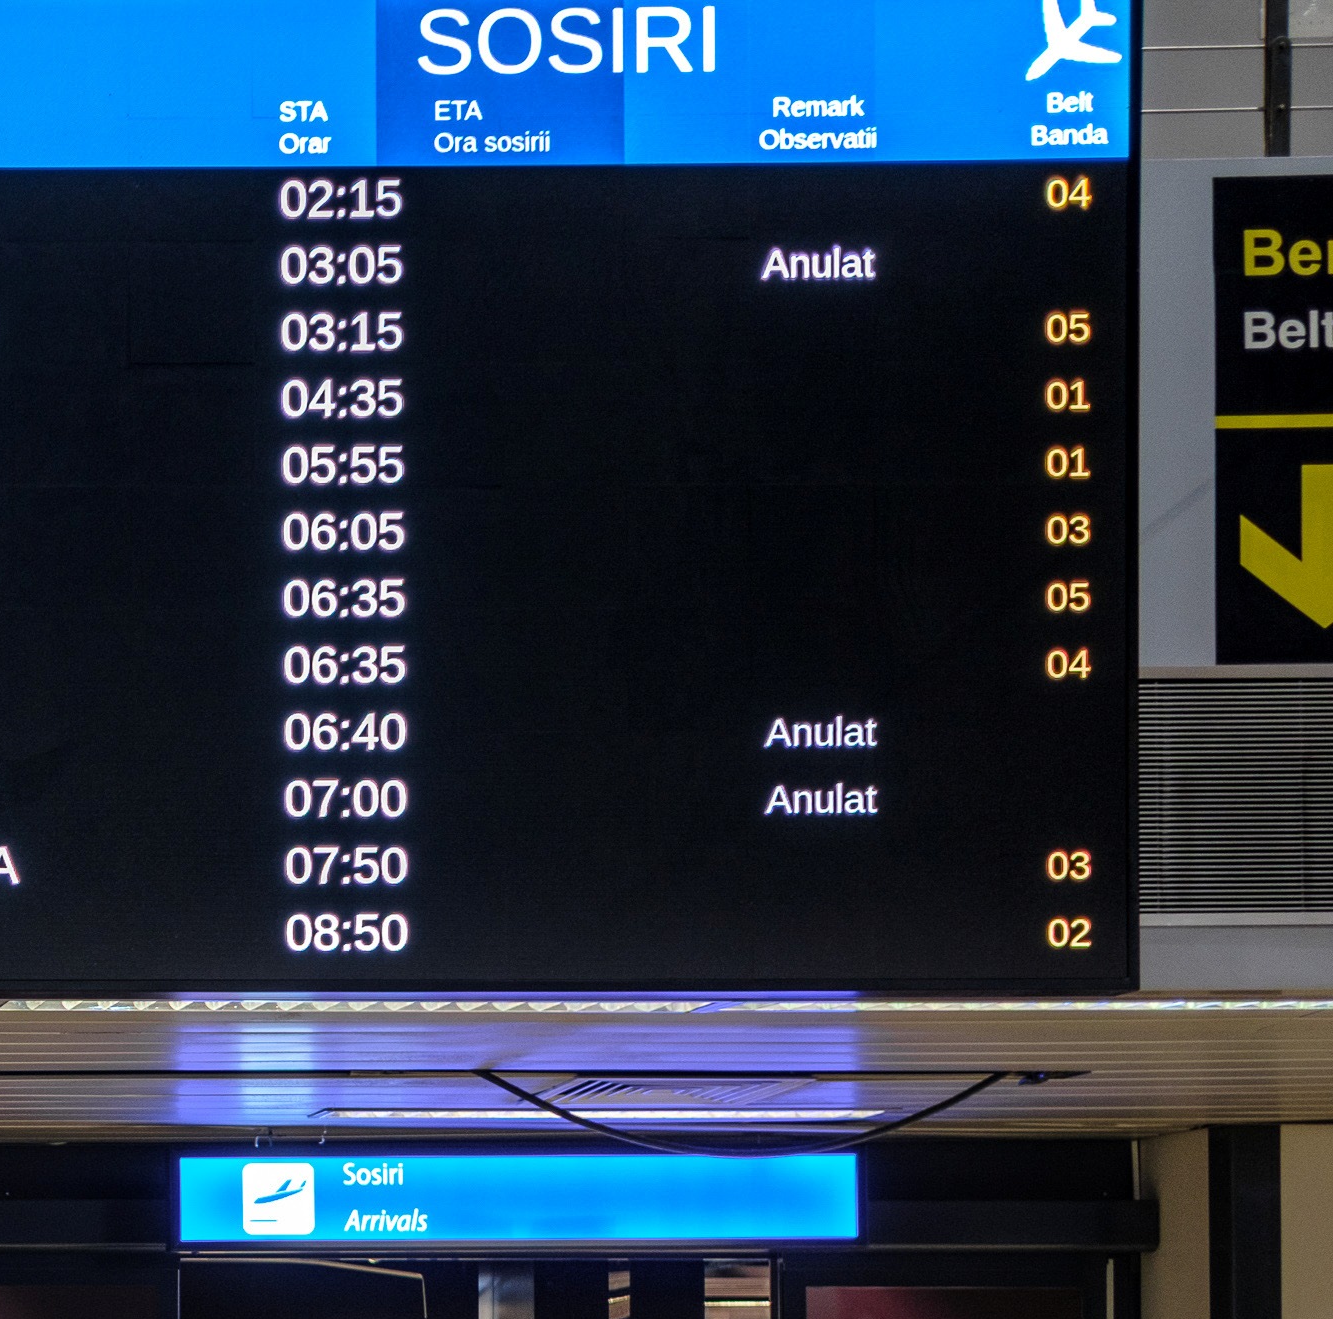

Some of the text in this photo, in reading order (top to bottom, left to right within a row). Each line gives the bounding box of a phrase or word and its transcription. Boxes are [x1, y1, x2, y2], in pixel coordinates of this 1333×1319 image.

[418, 6, 717, 76] SOSIRI
[280, 101, 330, 124] STA
[435, 100, 484, 122] ETA
[773, 95, 866, 119] Remark
[1047, 91, 1095, 115] Belt
[279, 133, 333, 156] Orar
[434, 132, 551, 154] Ora sosirii
[759, 128, 878, 152] Observatii
[1032, 124, 1110, 148] Banda
[281, 180, 404, 221] 02:15
[1046, 176, 1094, 211] 04
[281, 246, 404, 286] 03:05
[761, 245, 878, 282] Anulat
[1244, 229, 1333, 278] Be
[281, 312, 404, 353] 03:15
[1046, 311, 1093, 344] 05
[281, 379, 404, 420] 04:35
[1046, 379, 1092, 411] 01
[282, 445, 406, 487] 05:55
[1046, 446, 1092, 479] 01
[283, 511, 407, 552] 06:05
[1046, 514, 1093, 547] 03
[284, 579, 407, 619] 06:35
[1046, 582, 1093, 614] 05
[284, 646, 407, 687] 06:35
[1046, 648, 1093, 680] 04
[284, 713, 409, 752] 06:40
[764, 716, 879, 749] Anulat
[284, 780, 409, 819] 07:00
[765, 783, 879, 815] Anulat
[285, 847, 410, 886] 07:50
[1047, 850, 1093, 881] 03
[286, 914, 410, 953] 08:50
[1047, 917, 1093, 949] 02
[343, 1162, 405, 1187] Sosiri
[345, 1209, 429, 1233] Arrivals
